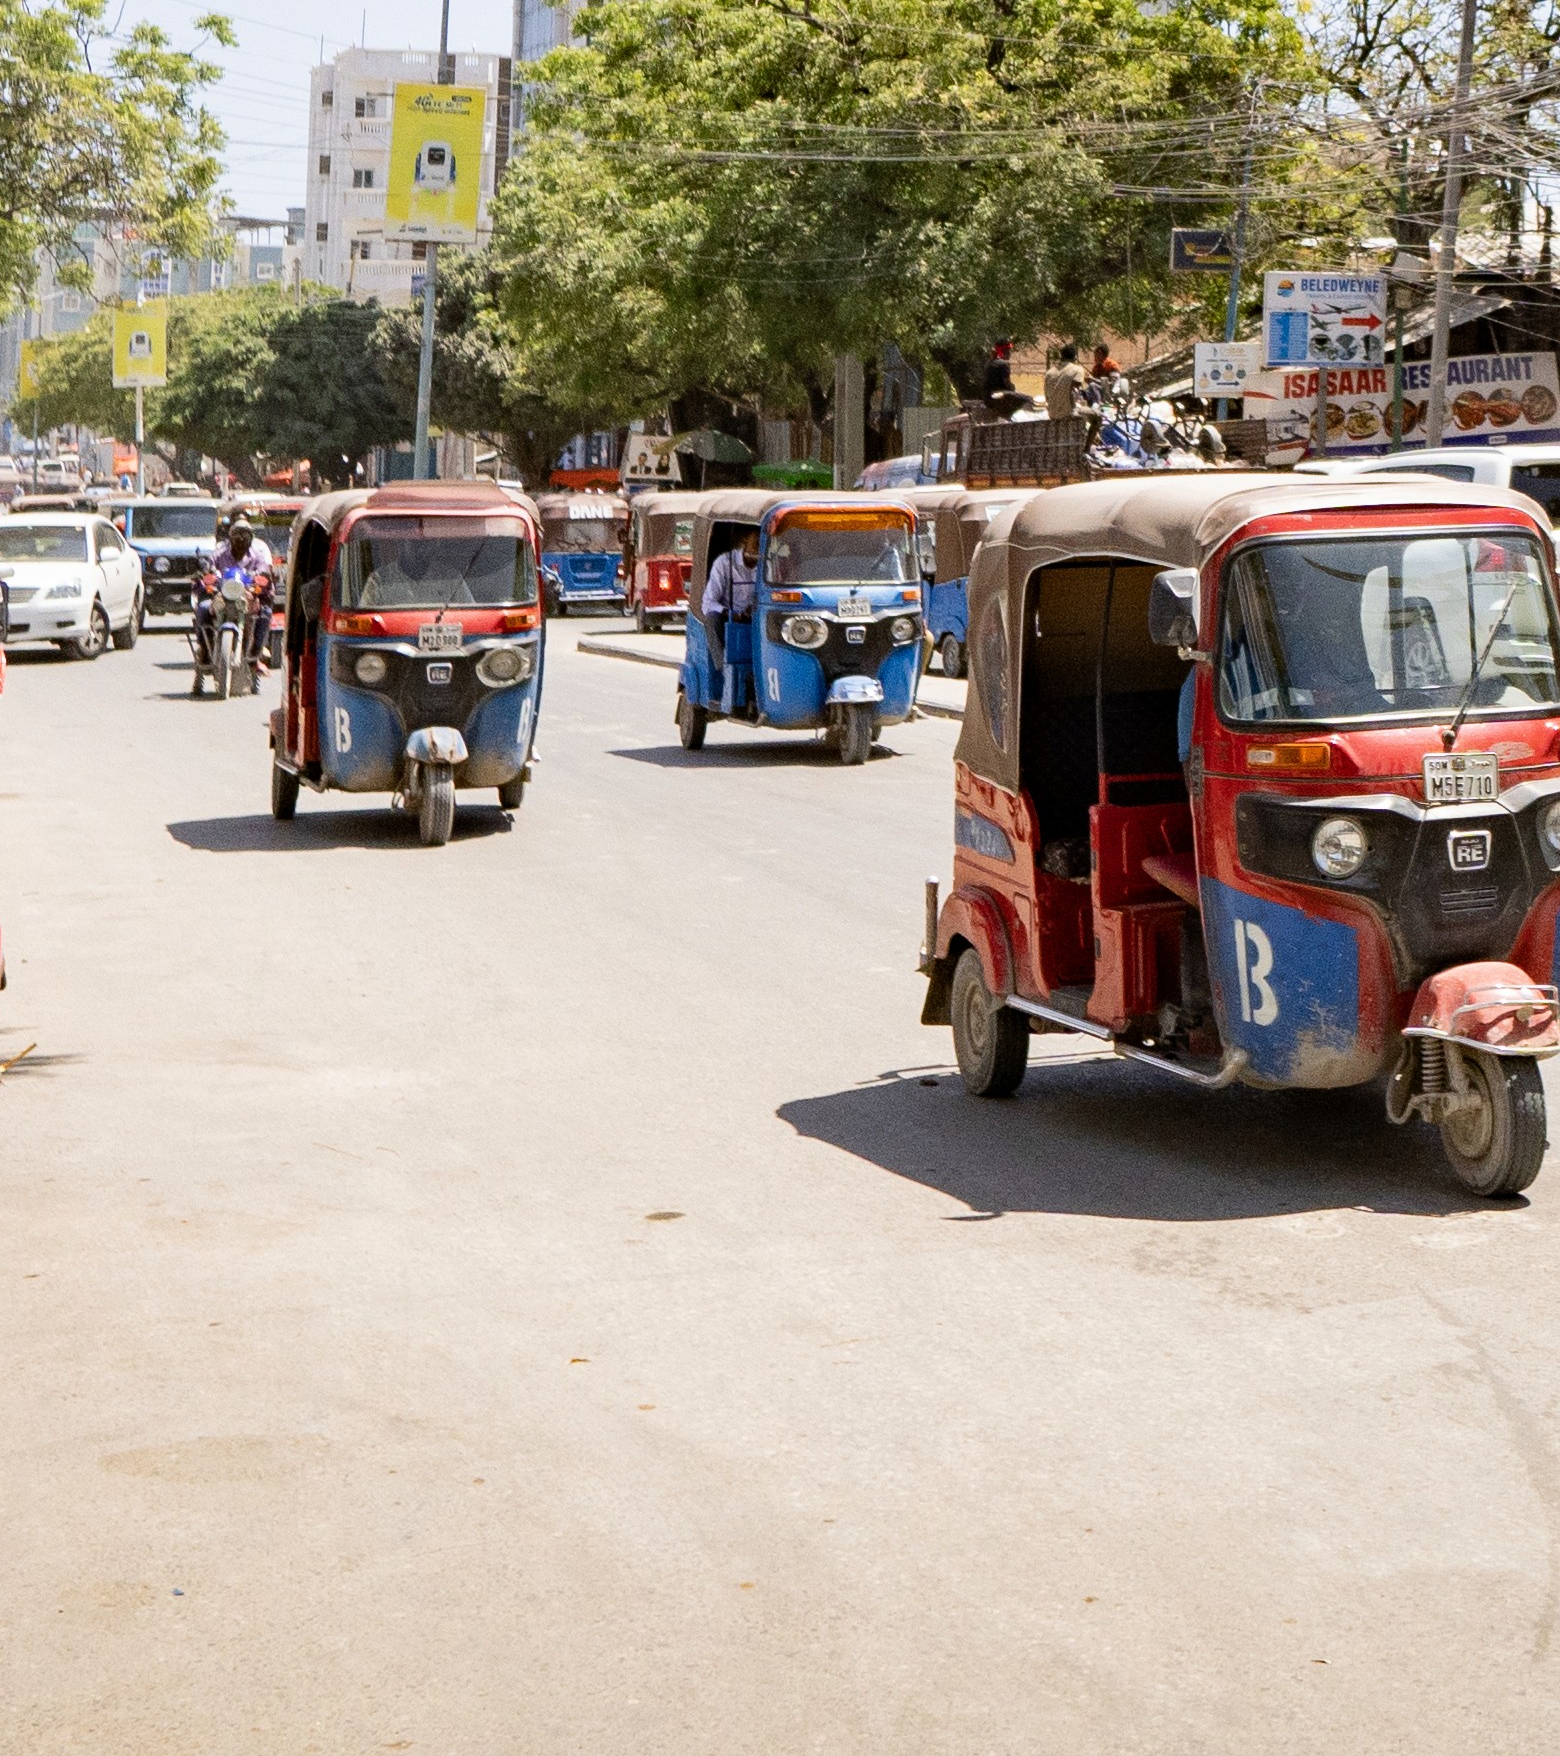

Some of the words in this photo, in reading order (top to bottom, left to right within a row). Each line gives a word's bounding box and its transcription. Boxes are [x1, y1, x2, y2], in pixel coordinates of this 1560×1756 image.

[1300, 278, 1380, 293] BELEDWEYNE
[1400, 355, 1533, 391] RESAURANT
[332, 706, 353, 754] B
[1428, 761, 1448, 771] SOM
[1432, 775, 1493, 798] M5E710
[1456, 844, 1485, 863] RE
[1233, 919, 1280, 1027] B
